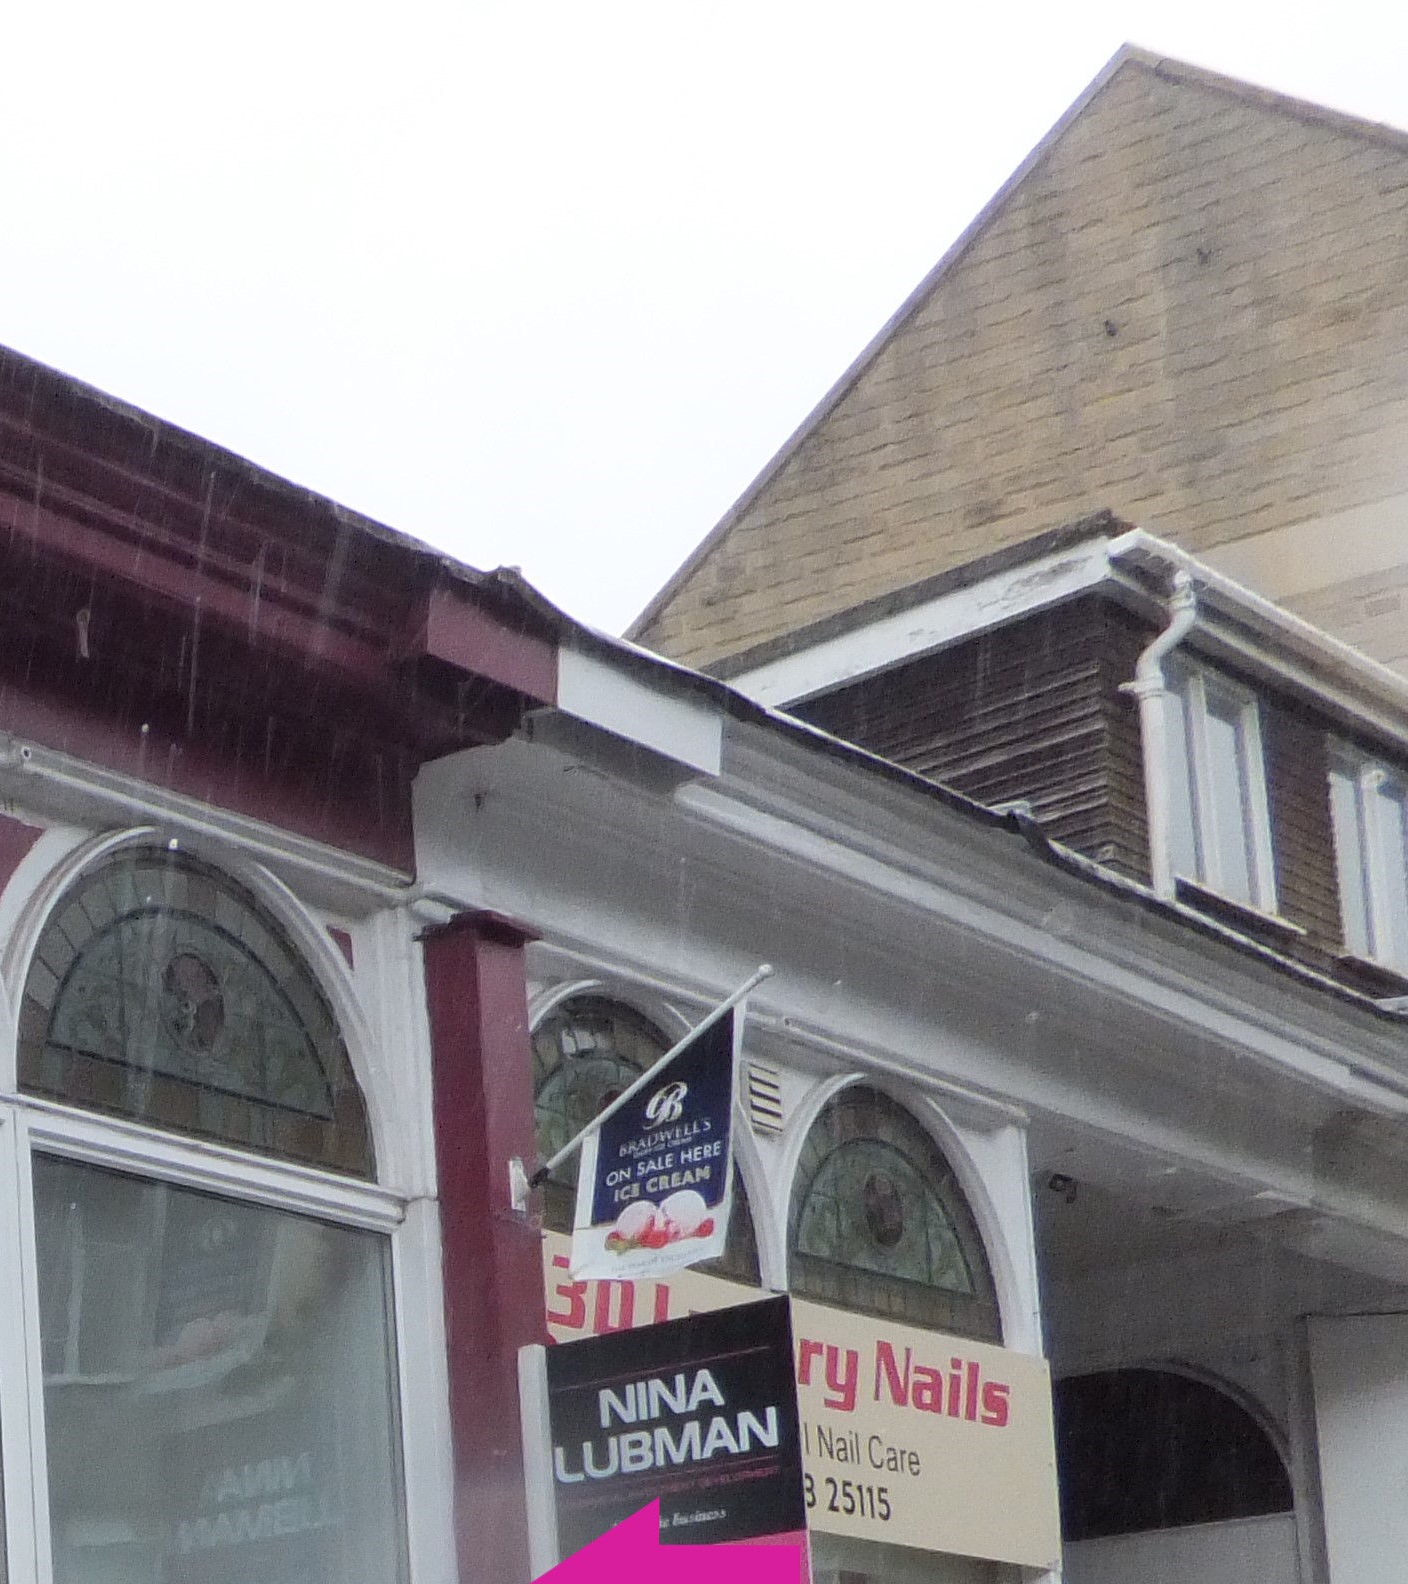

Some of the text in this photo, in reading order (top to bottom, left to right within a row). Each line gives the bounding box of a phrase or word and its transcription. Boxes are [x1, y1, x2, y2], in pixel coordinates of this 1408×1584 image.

[606, 1141, 722, 1187] ON SALE HERE
[614, 1166, 712, 1203] ICE CREAM
[599, 1368, 725, 1429] NINA
[874, 1340, 1011, 1428] Nails
[553, 1406, 779, 1484] LUBMAN
[817, 1425, 862, 1465] Nail
[868, 1435, 921, 1477] Care
[672, 1509, 727, 1527] business
[825, 1476, 892, 1522] 25115
